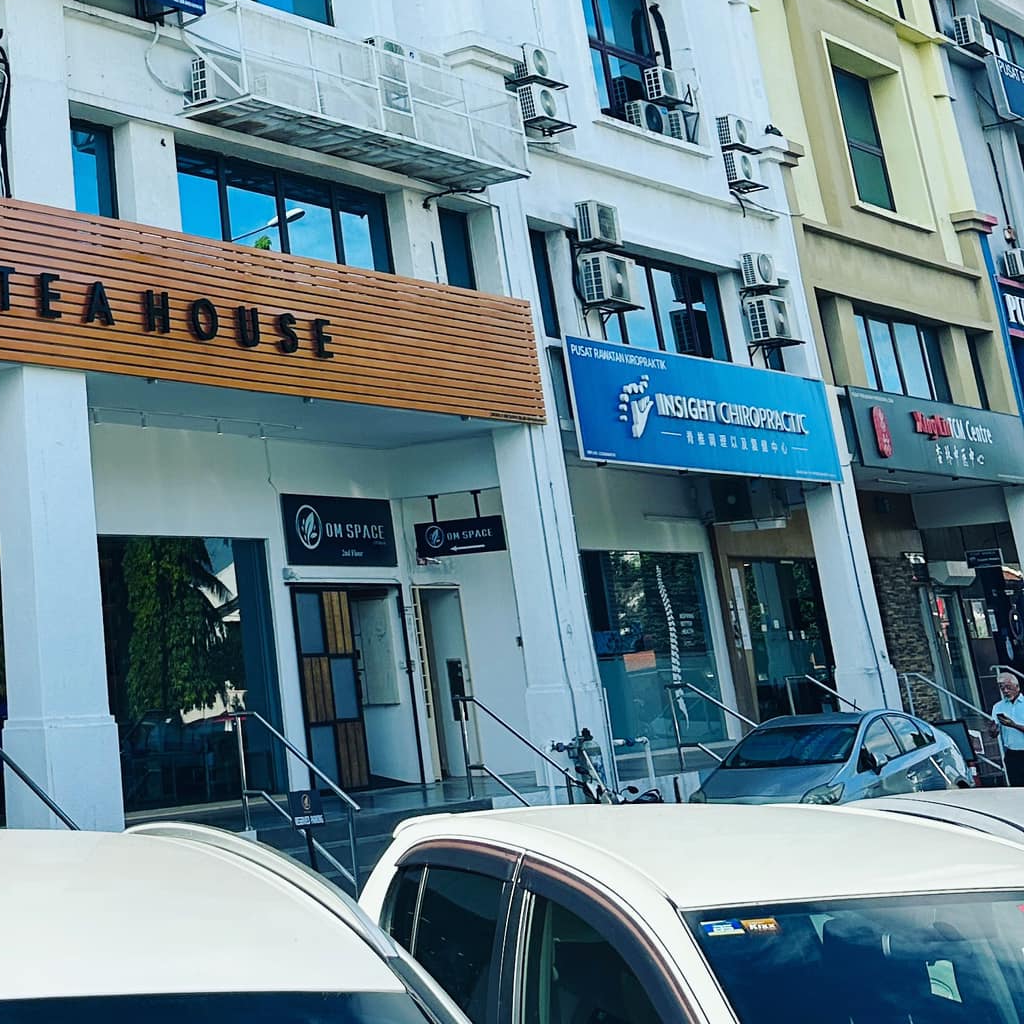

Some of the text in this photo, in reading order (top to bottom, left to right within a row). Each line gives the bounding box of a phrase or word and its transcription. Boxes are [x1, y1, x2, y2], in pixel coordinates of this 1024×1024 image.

[145, 289, 334, 359] HOUSE
[570, 344, 592, 358] PUSAT
[655, 393, 809, 435] INSIGHT CHIROPRACTIC
[965, 420, 993, 444] Centre
[326, 522, 385, 540] OM SPACE
[446, 528, 494, 541] OM SPACE
